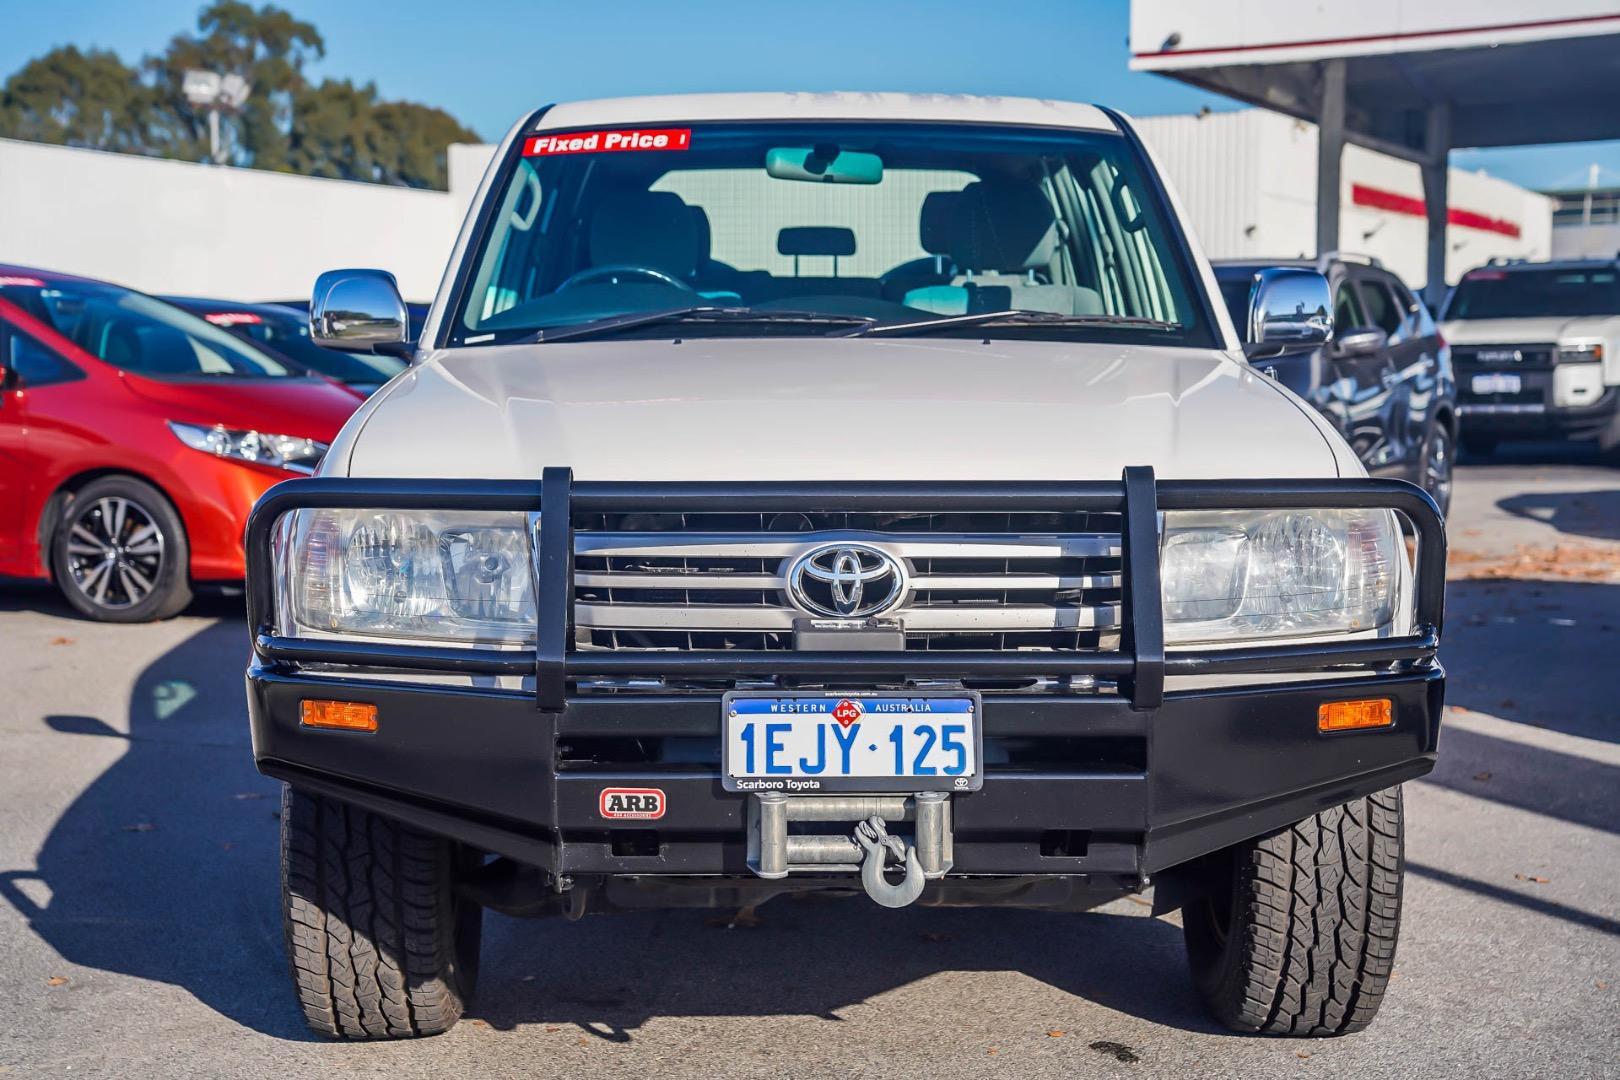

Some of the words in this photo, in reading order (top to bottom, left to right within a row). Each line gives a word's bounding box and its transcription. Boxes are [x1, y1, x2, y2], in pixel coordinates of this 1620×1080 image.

[533, 134, 599, 153] Fixed
[605, 133, 669, 149] Price
[770, 704, 826, 713] WESTERN
[875, 704, 932, 712] AUSTRALIA
[736, 779, 784, 790] Scarboro
[786, 779, 820, 791] Toyota
[608, 795, 658, 811] ARB
